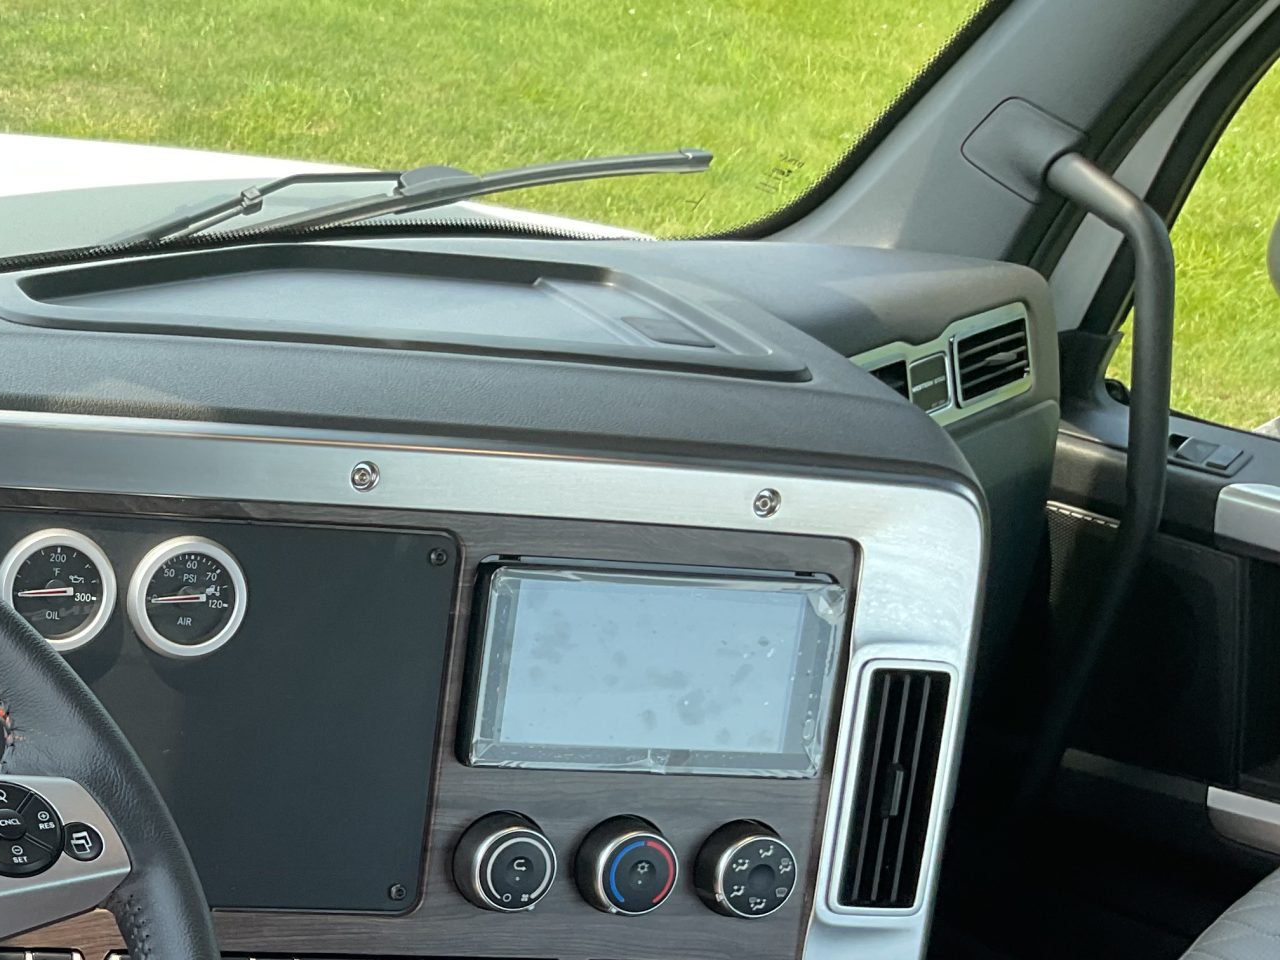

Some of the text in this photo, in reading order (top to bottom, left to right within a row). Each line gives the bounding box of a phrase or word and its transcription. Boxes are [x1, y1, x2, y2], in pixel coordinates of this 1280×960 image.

[50, 553, 67, 563] 200
[186, 560, 198, 570] 60
[164, 568, 175, 578] 50
[206, 572, 218, 581] 70
[183, 573, 197, 583] PSI
[74, 592, 92, 602] 300
[208, 600, 224, 609] 120
[45, 610, 61, 620] OIL
[177, 617, 192, 626] AIR
[0, 819, 21, 827] CNCL
[39, 821, 56, 830] RES
[12, 855, 28, 864] SET
